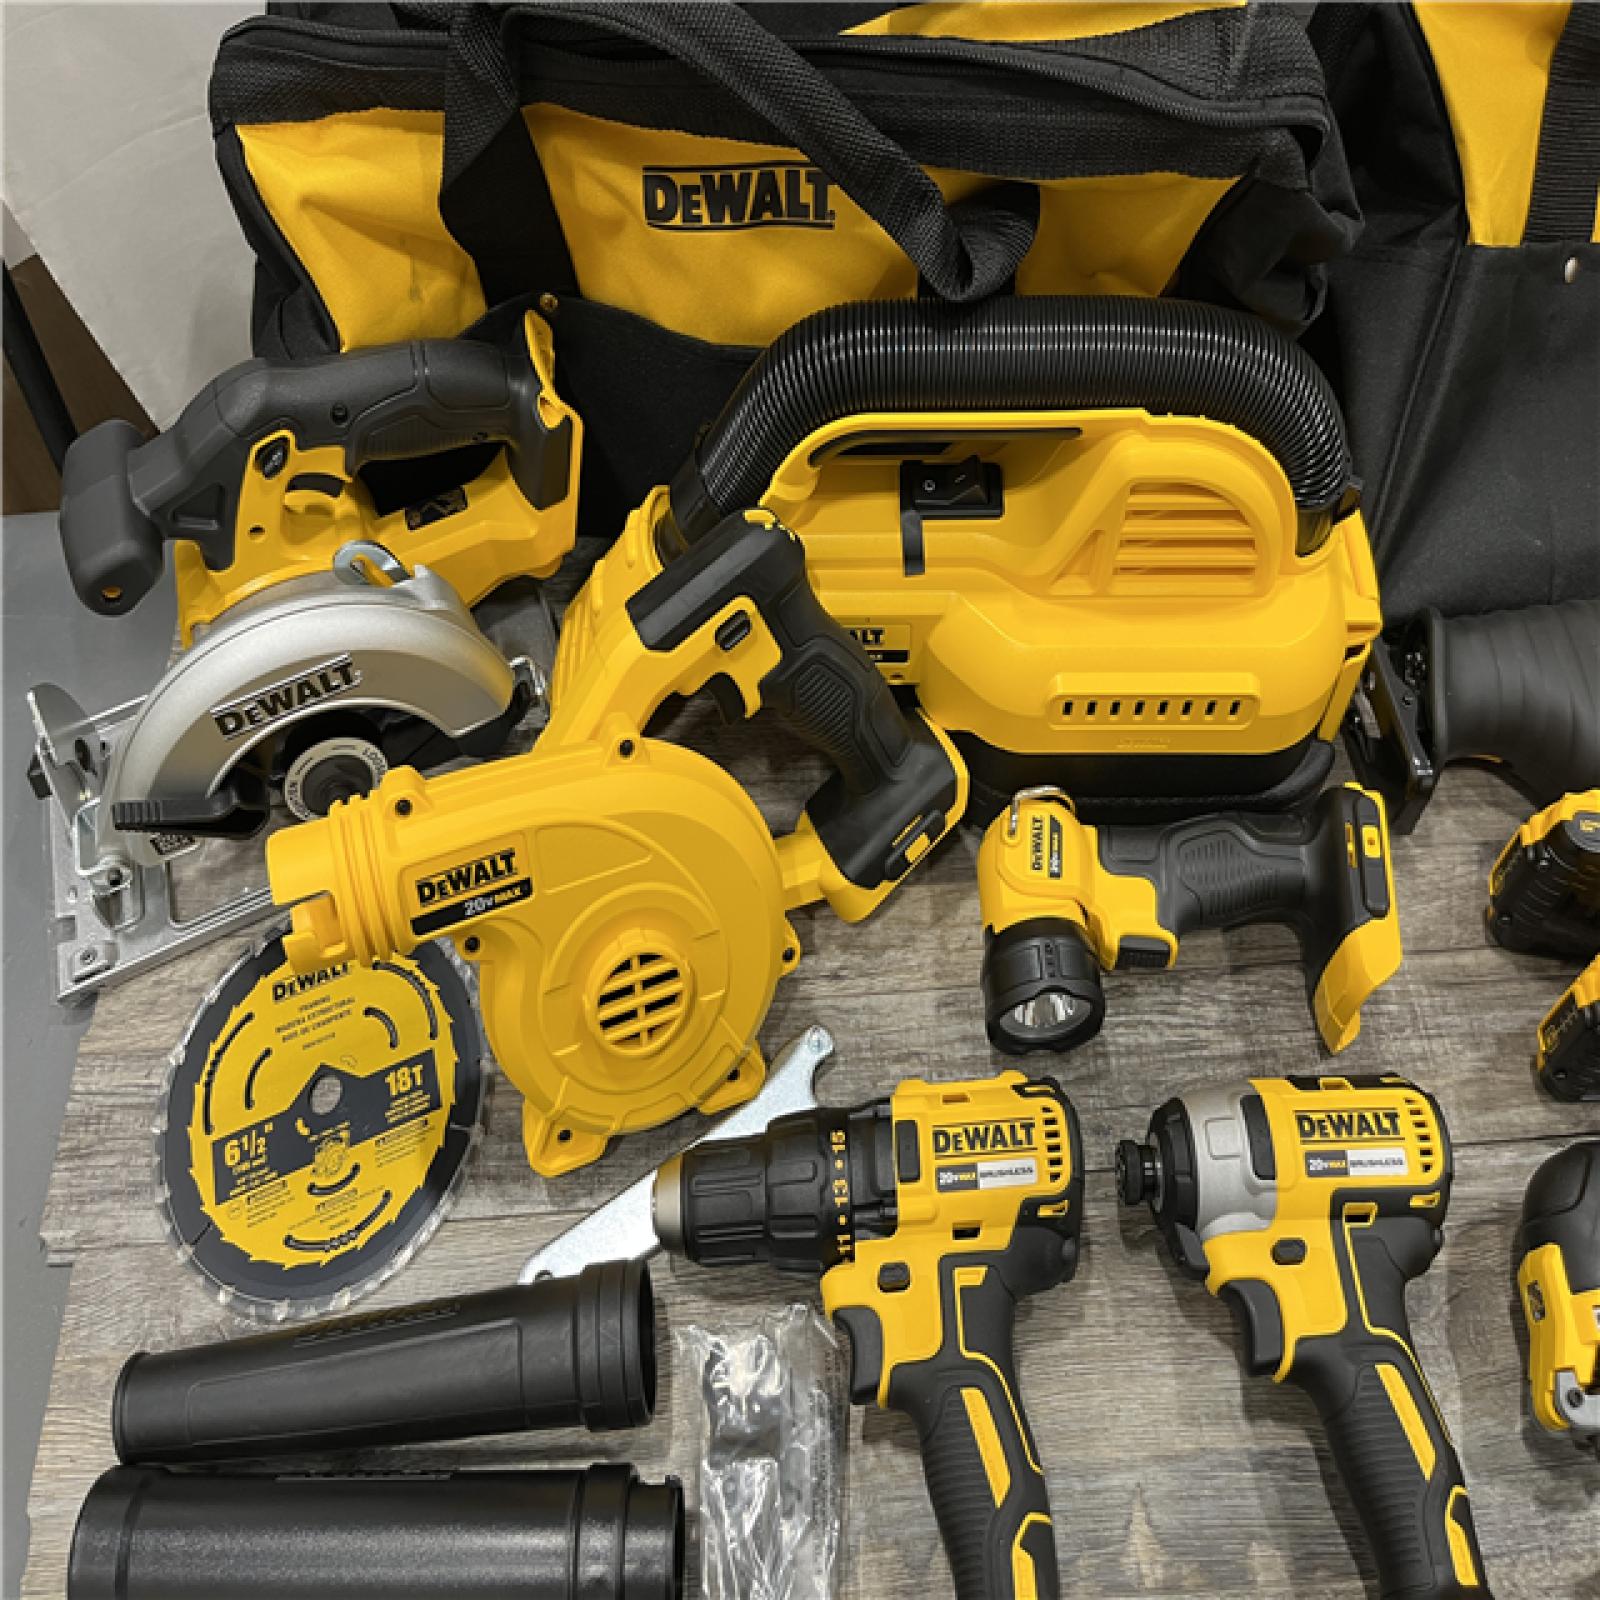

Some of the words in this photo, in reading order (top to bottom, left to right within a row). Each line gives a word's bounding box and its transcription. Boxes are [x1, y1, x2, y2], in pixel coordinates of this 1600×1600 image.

[213, 658, 355, 736] DEWALT
[416, 848, 517, 906] DEWALT
[384, 1064, 424, 1097] 18T
[830, 1129, 846, 1155] 15
[932, 1119, 1036, 1154] DEWALT
[1295, 1110, 1401, 1140] DEWALT
